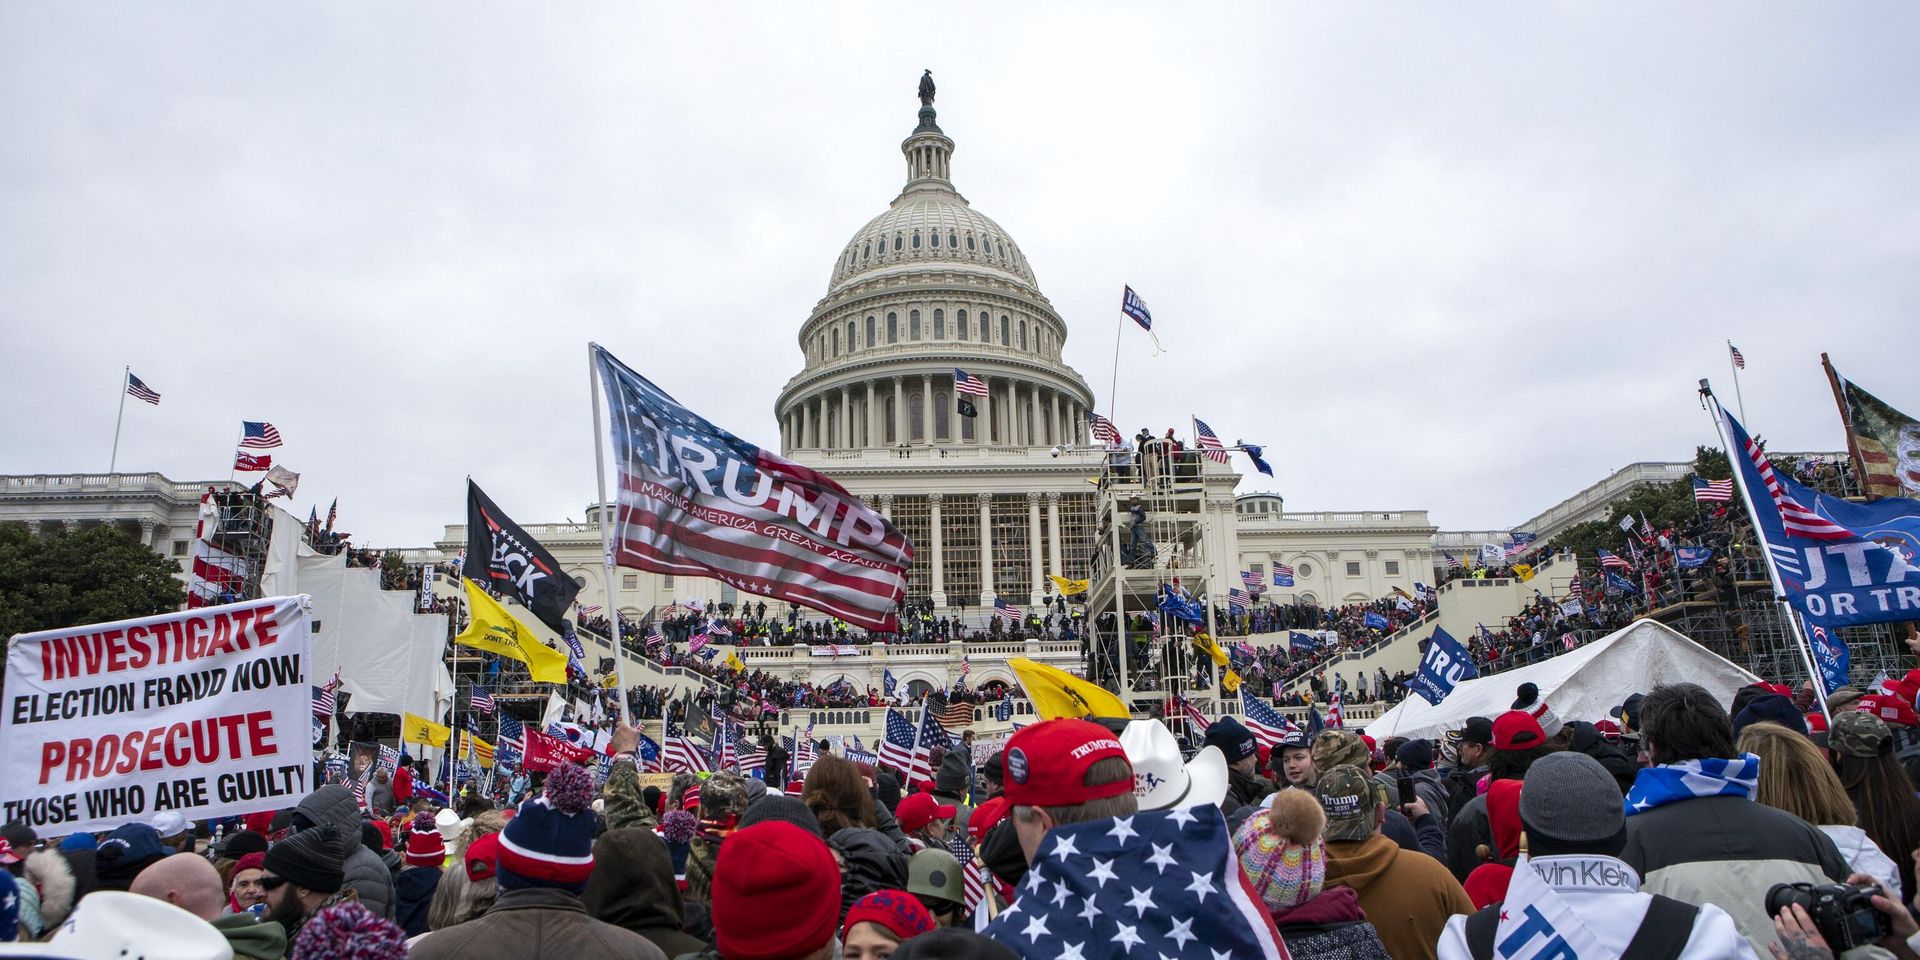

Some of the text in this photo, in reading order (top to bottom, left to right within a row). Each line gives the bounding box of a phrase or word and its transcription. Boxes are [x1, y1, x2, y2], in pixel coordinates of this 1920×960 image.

[641, 415, 885, 547] TRUMP
[642, 482, 888, 570] MAKING AMERICA GREAT AGAIN!
[423, 567, 432, 607] TRUMP
[41, 605, 278, 680] INVESTIGATE
[570, 634, 584, 657] TRUMP
[12, 654, 304, 725] ELECTION FRAUD NOW.
[39, 711, 277, 784] PROSECUTE
[847, 752, 876, 765] TRUMP
[1071, 739, 1107, 759] TRUMP
[4, 764, 304, 826] THOSE WHO ARE GUILTY
[1322, 794, 1359, 805] Trump
[1581, 861, 1629, 887] Klein
